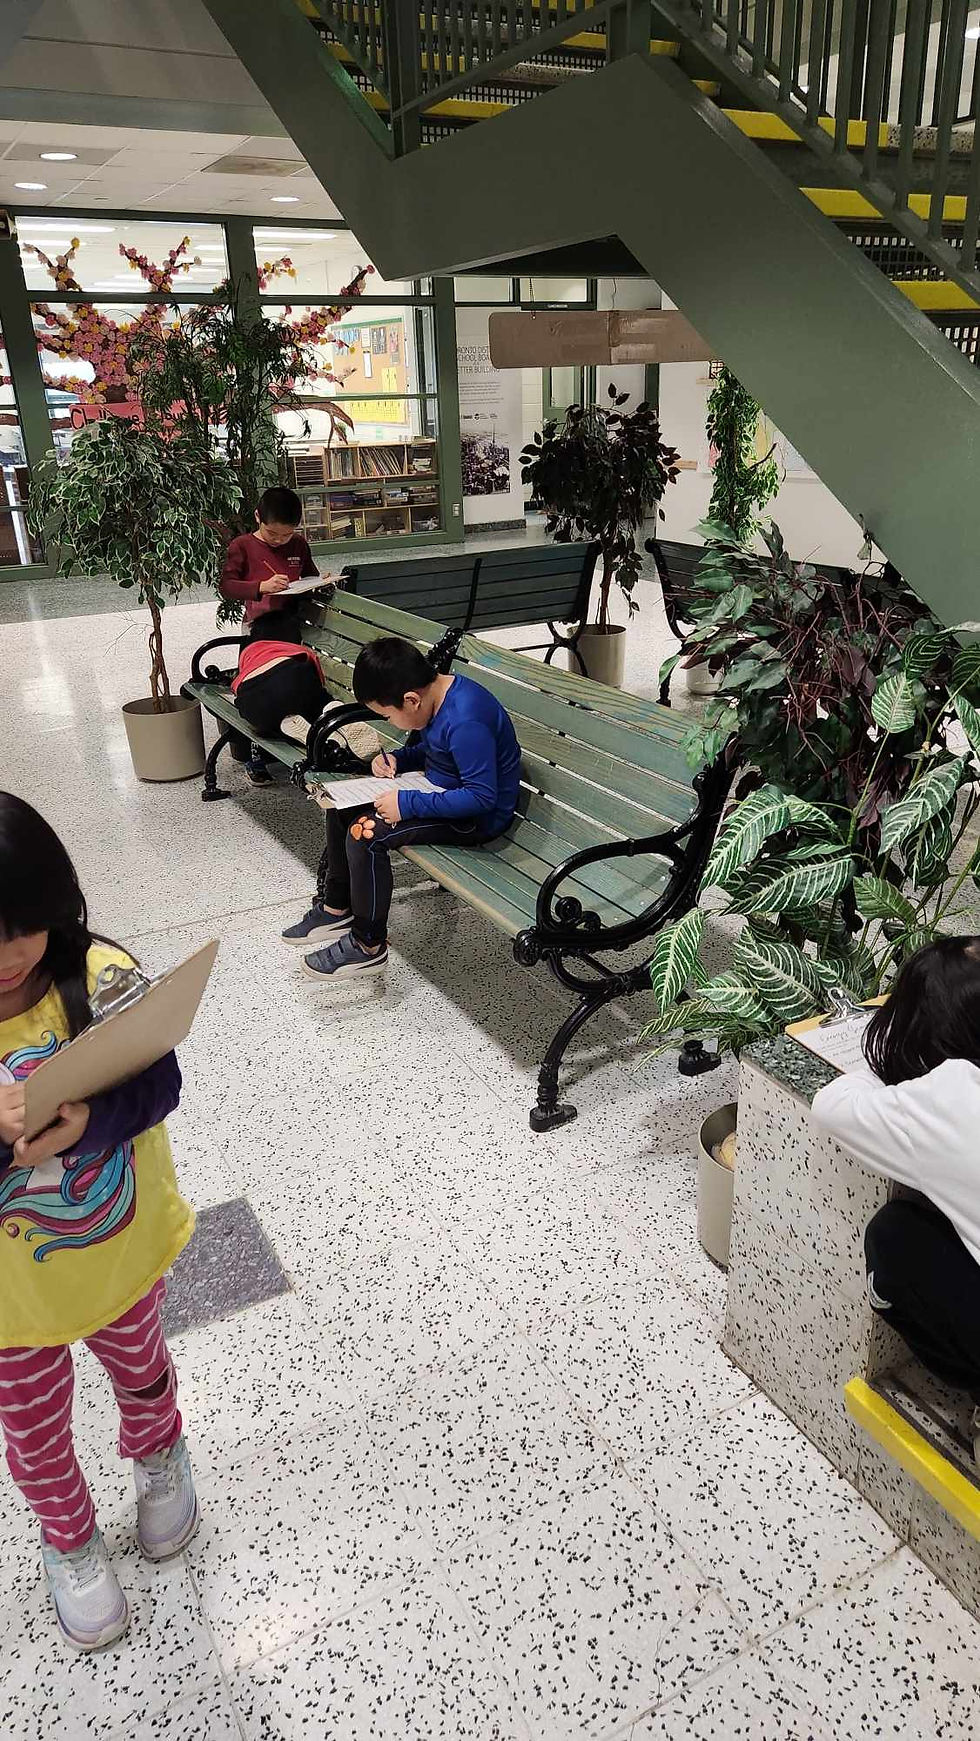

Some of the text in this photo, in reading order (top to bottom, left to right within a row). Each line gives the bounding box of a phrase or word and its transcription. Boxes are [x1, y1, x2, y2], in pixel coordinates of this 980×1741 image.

[458, 345, 489, 354] RONTO DIST
[458, 353, 490, 362] CHOOL BOA
[458, 365, 473, 374] ETTER
